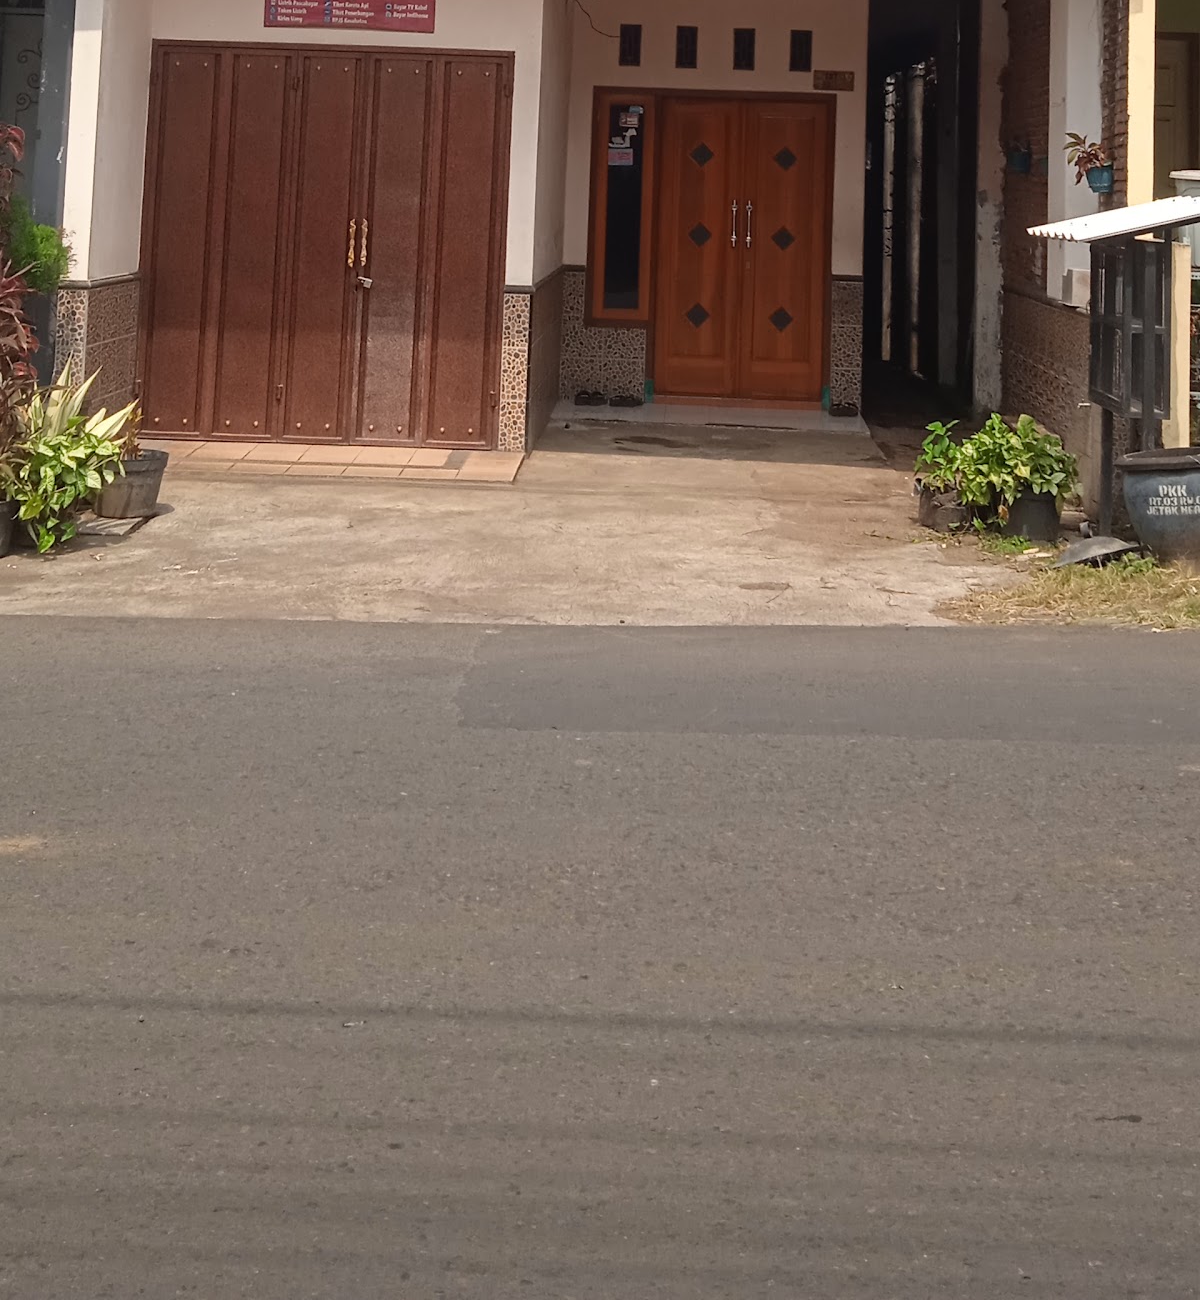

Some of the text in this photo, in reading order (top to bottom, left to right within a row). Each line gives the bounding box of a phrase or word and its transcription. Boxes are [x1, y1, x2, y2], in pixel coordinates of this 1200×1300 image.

[293, 0, 319, 8] Pascabayar
[393, 3, 407, 11] Bayar
[345, 9, 374, 18] Penerbangan
[393, 11, 406, 19] Bayar
[290, 15, 303, 23] Uang
[1158, 484, 1187, 497] PKK
[1149, 496, 1178, 506] RT.03
[1146, 505, 1179, 516] JETAK
